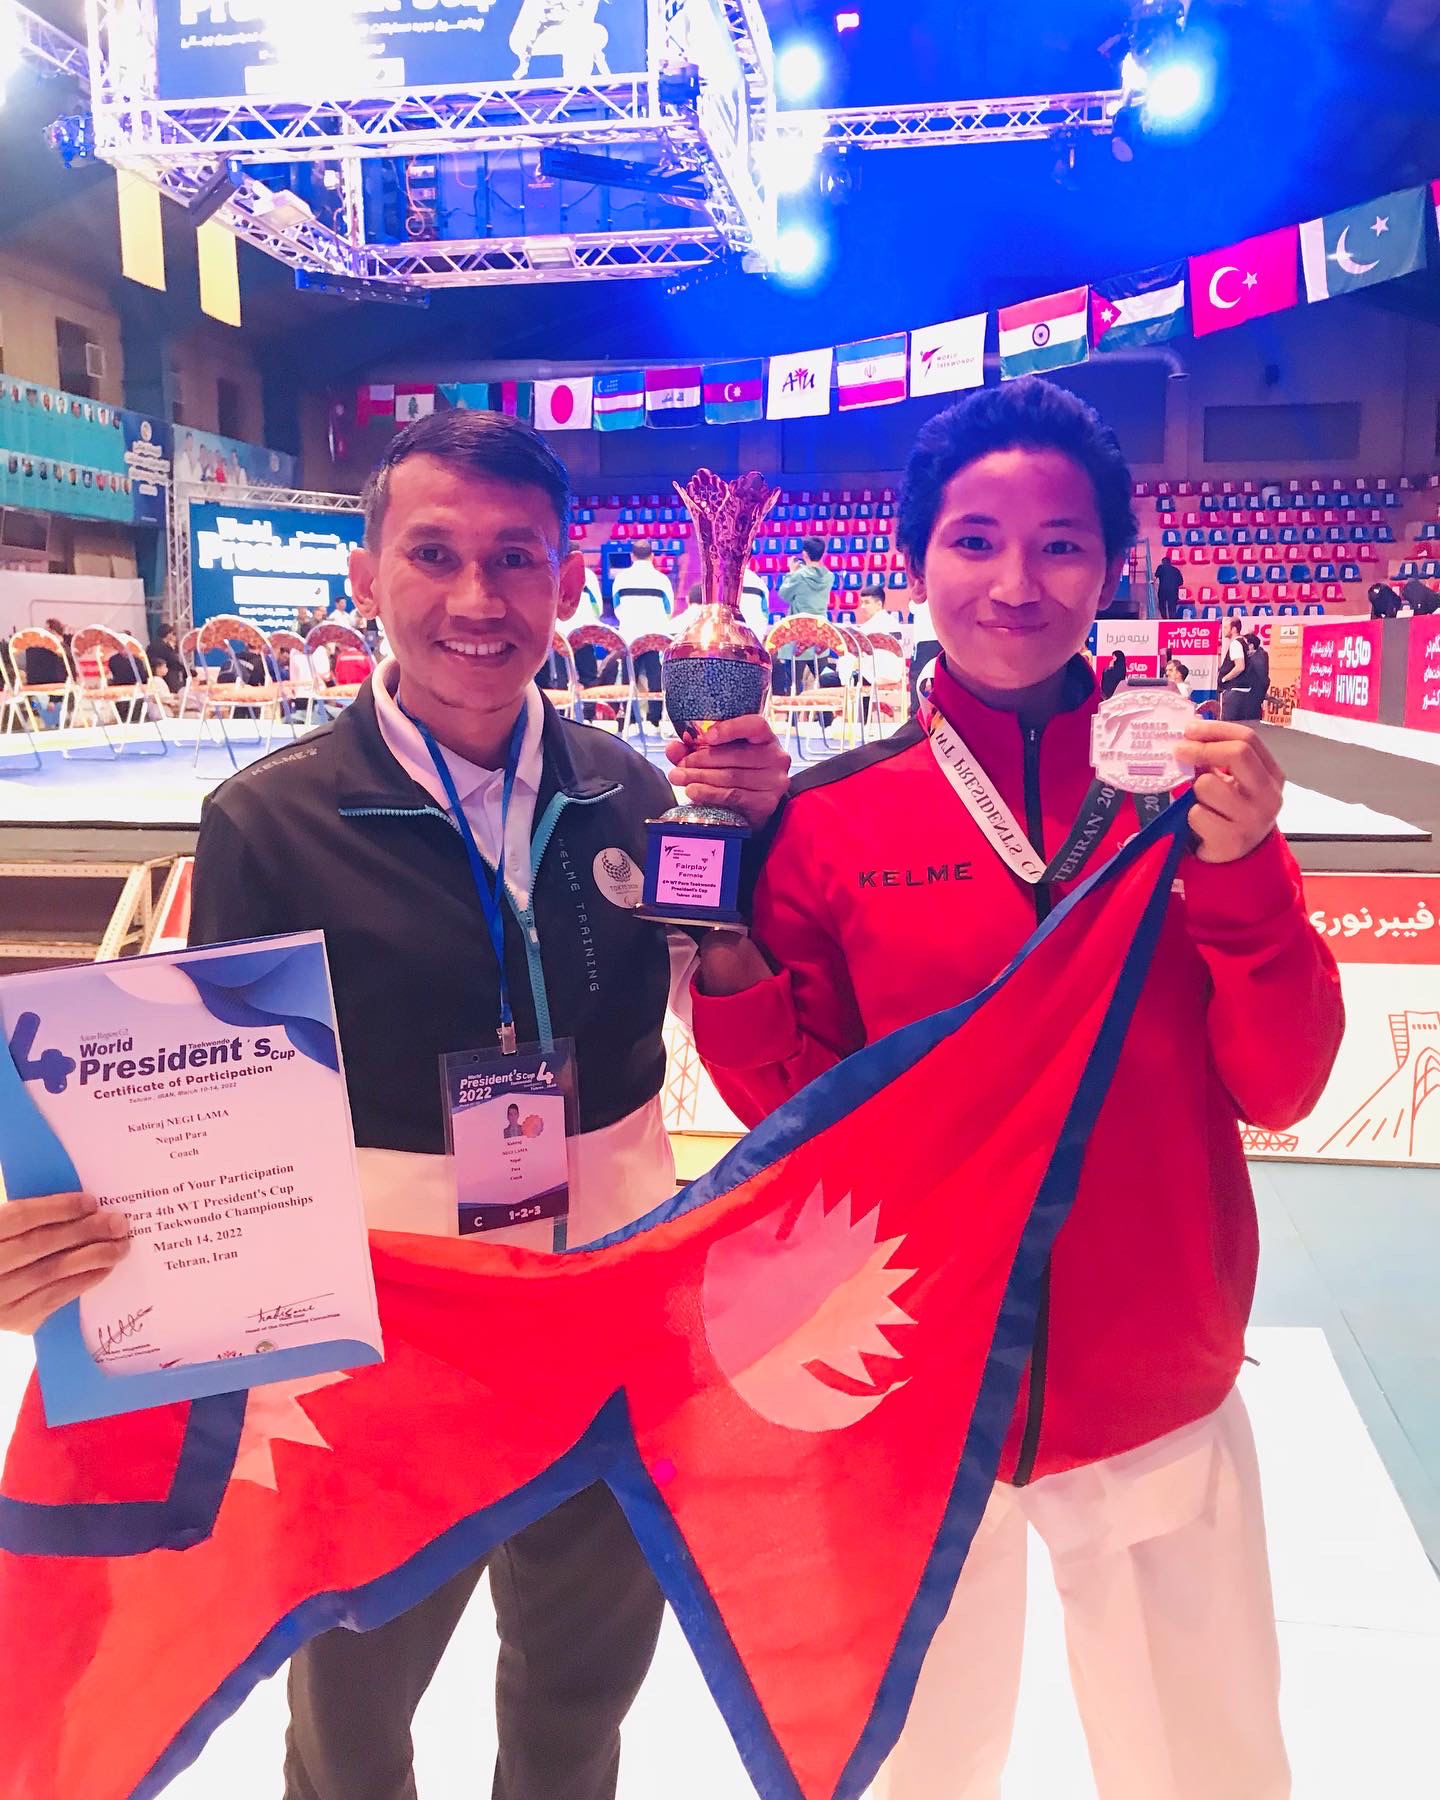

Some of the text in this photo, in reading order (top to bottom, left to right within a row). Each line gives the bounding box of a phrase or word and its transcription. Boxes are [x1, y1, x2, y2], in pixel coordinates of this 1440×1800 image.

[1053, 812, 1104, 880] TEHRAN
[675, 862, 707, 872] Fairplay
[858, 861, 973, 888] KELME
[1309, 901, 1435, 938] نوری فیبر
[574, 902, 600, 993] TRAINING
[79, 1037, 134, 1059] World
[187, 1038, 231, 1050] Taekwondo
[270, 1048, 296, 1061] Cup
[93, 1064, 274, 1100] Certificate of Participation
[460, 1061, 554, 1090] President's Cup 4
[459, 1086, 492, 1104] 2022
[127, 1109, 230, 1133] Kabiraj NEGI LAMA
[155, 1130, 208, 1145] Nepal Para
[169, 1148, 200, 1159] Coach
[98, 1164, 295, 1207] Recognition of Your Participation
[155, 1205, 175, 1217] 4th
[177, 1200, 201, 1212] WT
[203, 1188, 267, 1208] President's
[269, 1184, 295, 1196] Cup
[156, 1211, 222, 1232] Taekwondo
[224, 1195, 315, 1220] Championships
[474, 1205, 541, 1227] C 1-2-3
[152, 1227, 243, 1253] March 14, 2022
[163, 1250, 239, 1272] Tehran, Iran
